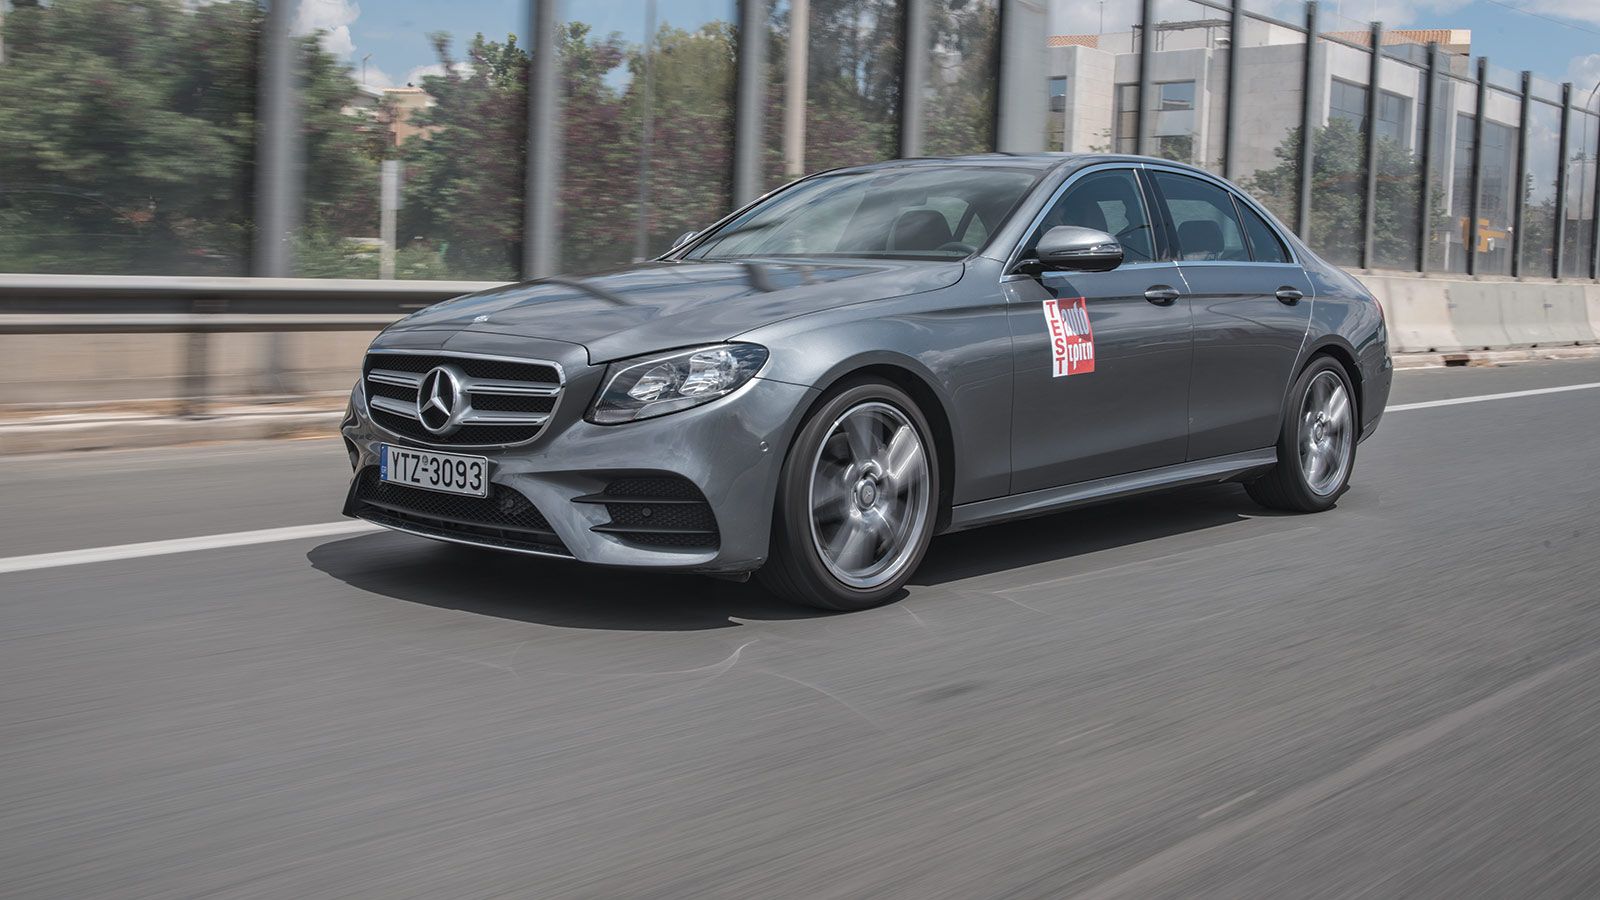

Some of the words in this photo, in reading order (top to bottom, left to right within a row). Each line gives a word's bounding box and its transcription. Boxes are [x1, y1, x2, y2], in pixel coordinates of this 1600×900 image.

[1046, 302, 1065, 374] TEST
[1061, 302, 1089, 336] auto
[392, 451, 482, 490] YTZ-3093
